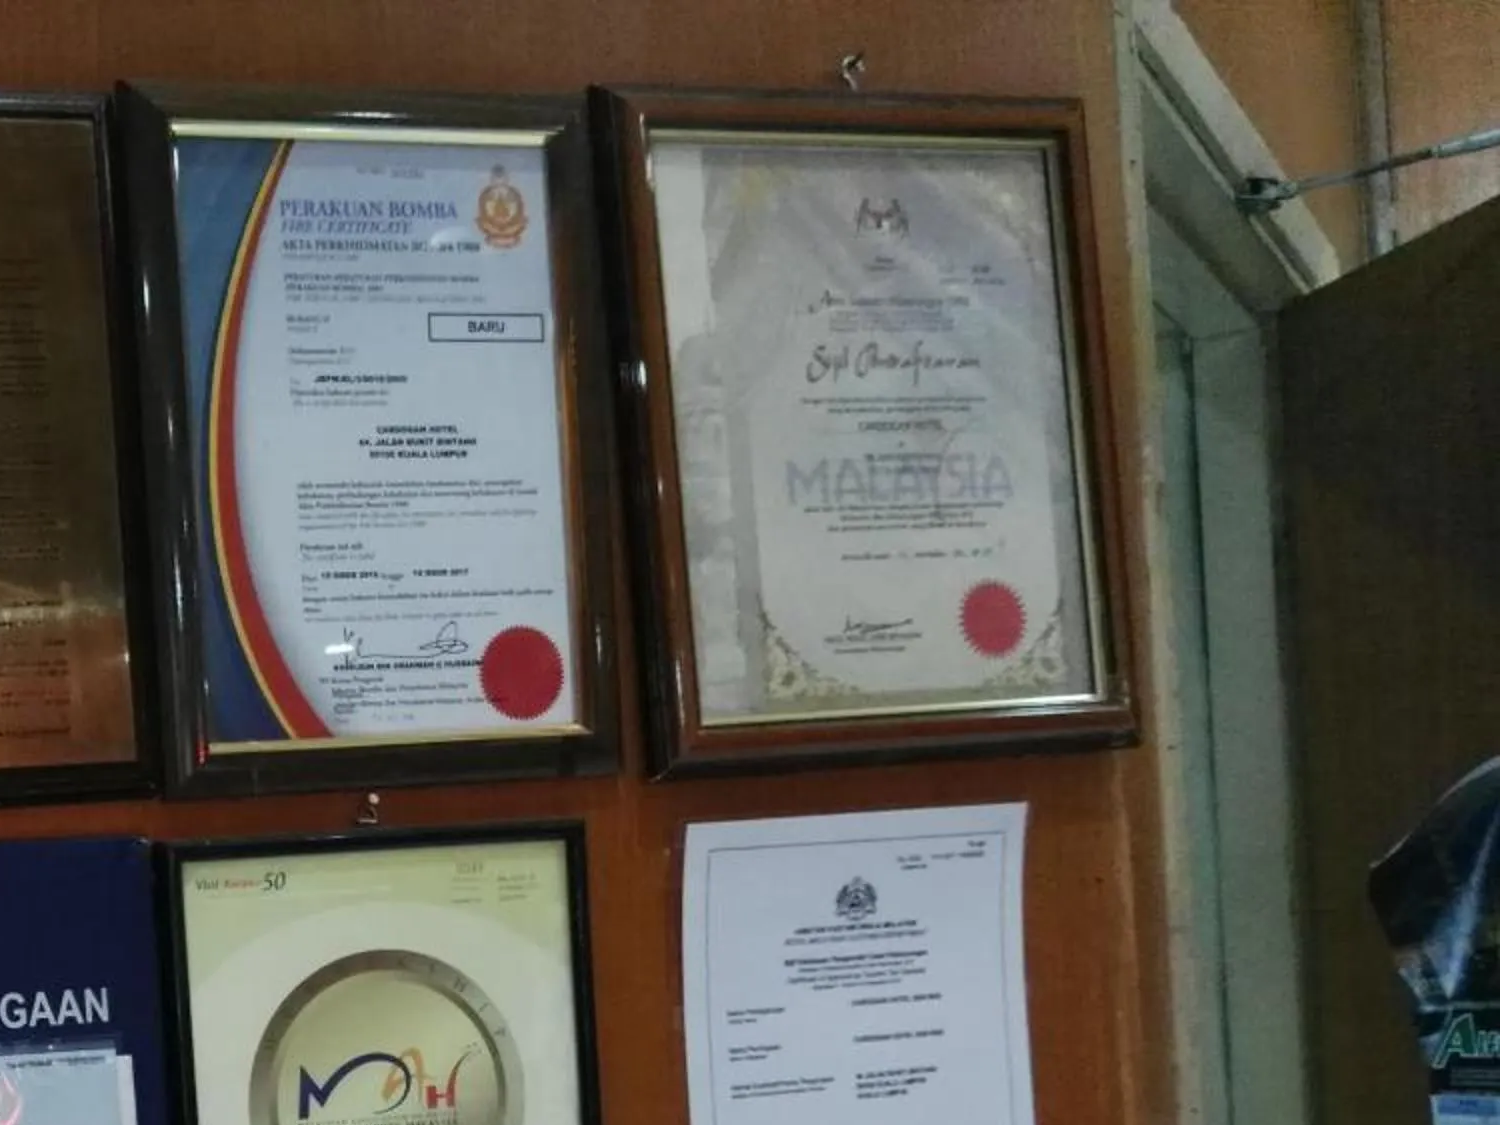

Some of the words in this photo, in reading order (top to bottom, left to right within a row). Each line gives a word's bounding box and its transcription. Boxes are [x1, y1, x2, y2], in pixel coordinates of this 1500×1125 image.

[280, 199, 383, 218] PERAKUAN
[388, 201, 458, 219] BOMBA
[467, 320, 506, 335] BARU
[785, 452, 1015, 507] MALAYSIA
